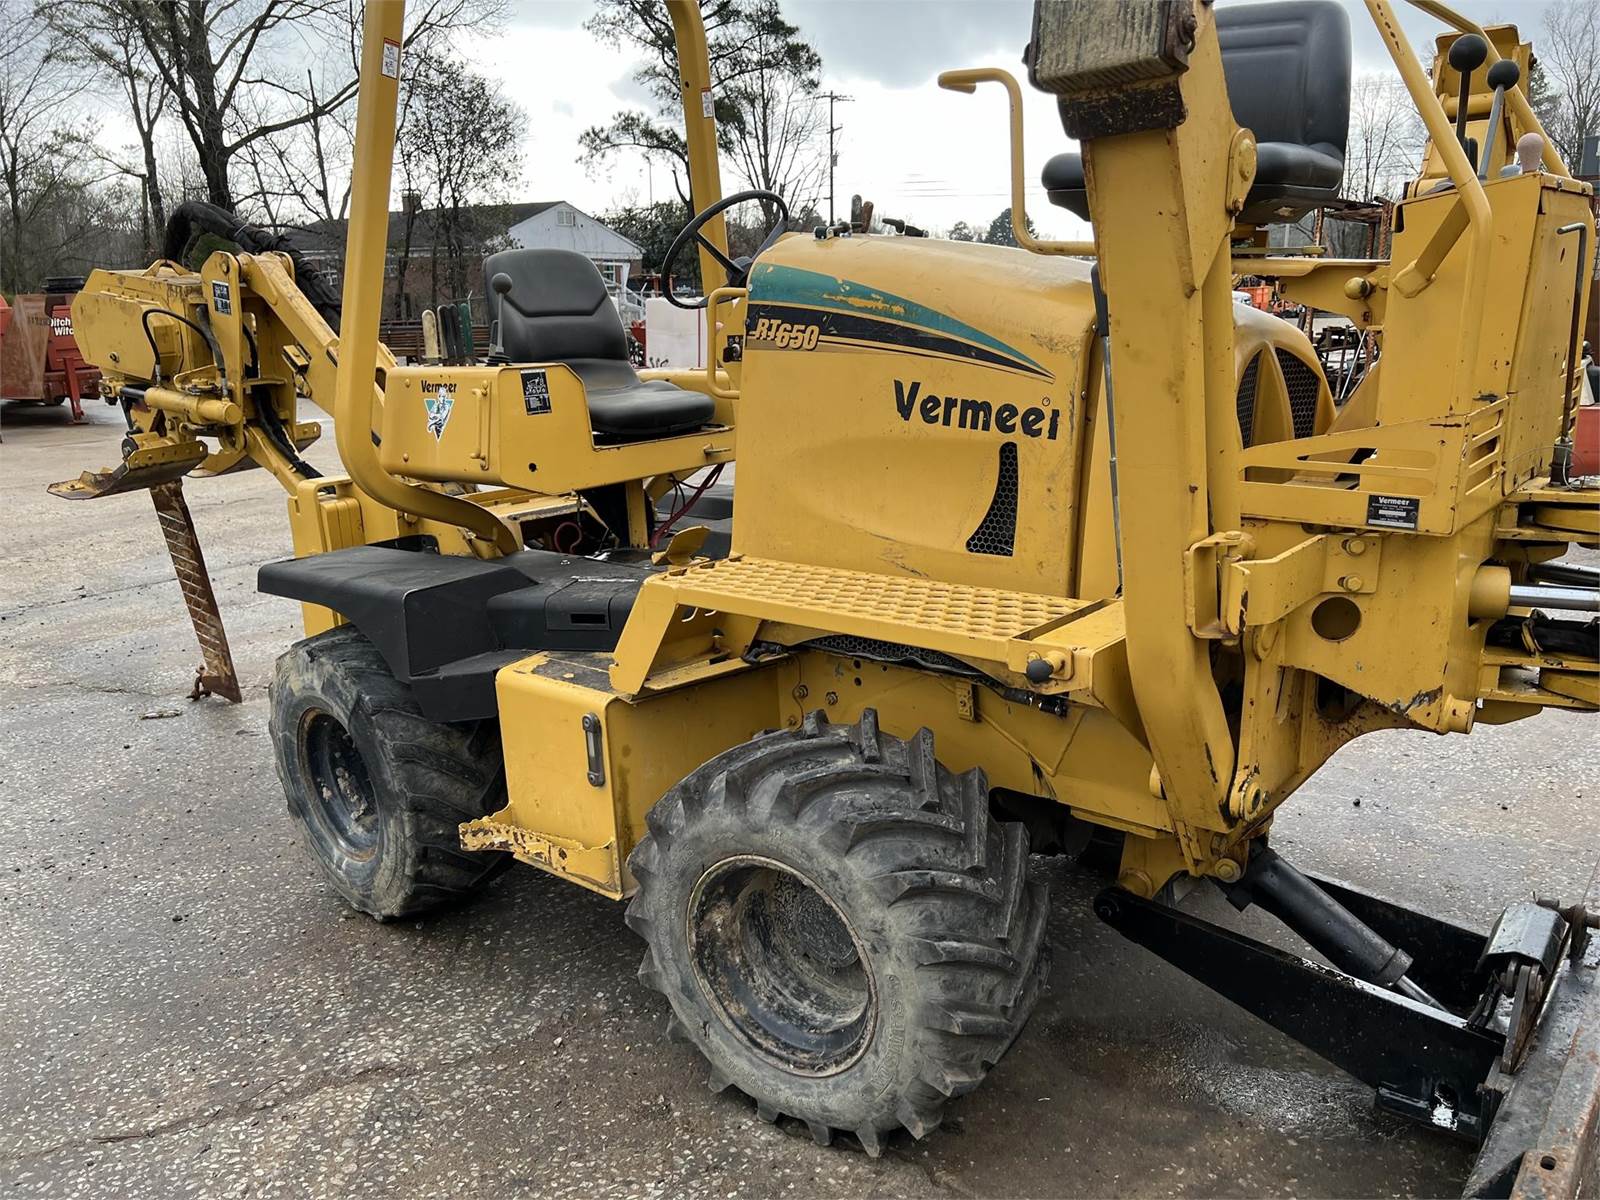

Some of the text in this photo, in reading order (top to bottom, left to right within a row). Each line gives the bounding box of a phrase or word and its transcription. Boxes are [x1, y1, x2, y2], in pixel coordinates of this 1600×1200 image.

[54, 327, 74, 336] Witc
[756, 318, 820, 351] RT650
[421, 380, 457, 393] Vermeer
[894, 379, 1060, 440] Vermeer
[1378, 496, 1410, 506] Vermeer
